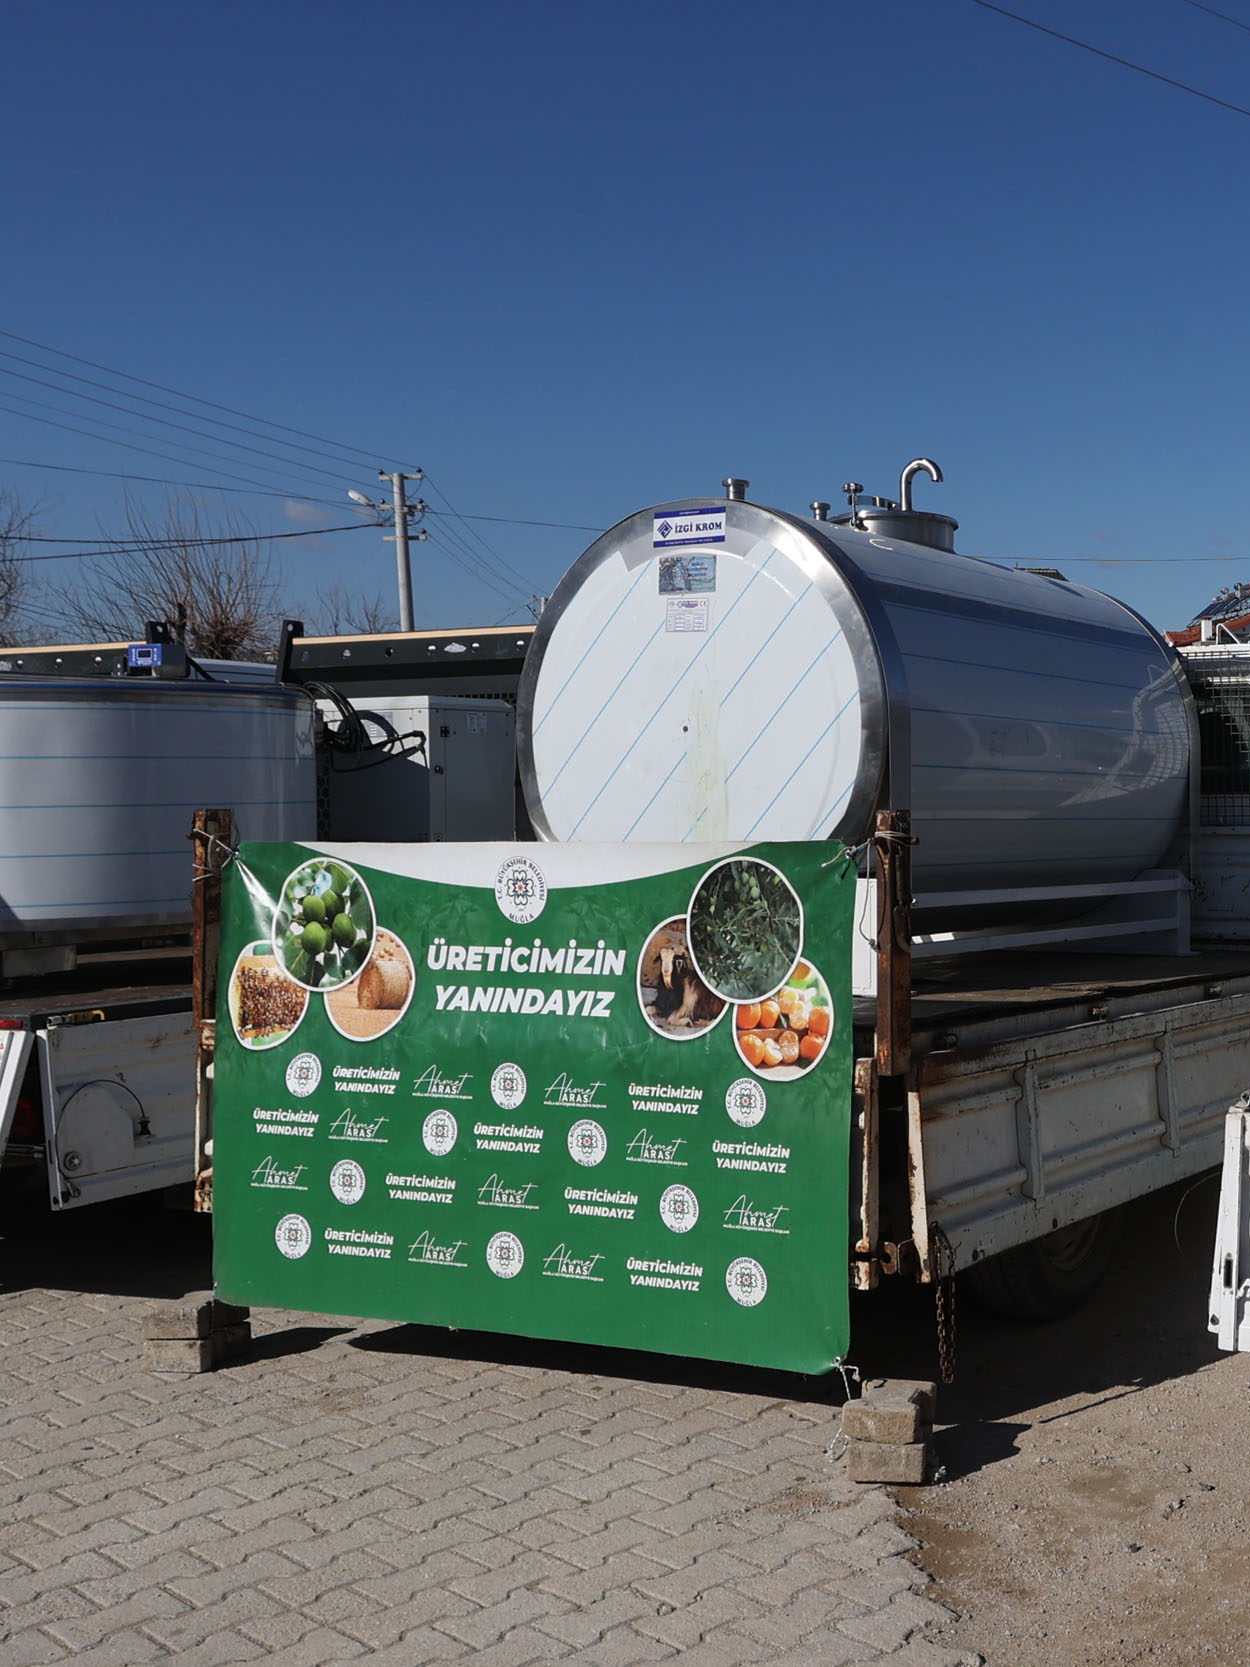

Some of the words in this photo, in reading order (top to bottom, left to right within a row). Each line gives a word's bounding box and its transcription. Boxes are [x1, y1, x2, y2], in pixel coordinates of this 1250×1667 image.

[674, 521, 693, 534] İZGİ
[695, 521, 722, 532] KROM
[497, 857, 527, 884] BÜYÜKŞEHİR
[528, 862, 545, 901] BELEDİYESİ
[508, 913, 534, 923] MUĞLA
[427, 937, 626, 976] ÜRETİCİMİZİN
[435, 984, 616, 1018] YANINDAYIZ
[333, 1066, 400, 1080] ÜRETİCİMİZİN
[413, 1064, 474, 1094] Ahmet
[335, 1082, 396, 1094] YANINDAYIZ
[431, 1085, 458, 1095] ARAS
[544, 1072, 607, 1103] Ahmet
[629, 1083, 703, 1099] ÜRETİCİMİZİN
[562, 1093, 589, 1103] ARAS
[632, 1100, 699, 1114] YANINDAYIZ
[253, 1108, 319, 1123] ÜRETİCİMİZİN
[329, 1107, 390, 1136] Ahmet
[256, 1124, 314, 1137] YANINDAYIZ
[346, 1129, 372, 1138] ARAS
[474, 1122, 544, 1139] ÜRETİCİMİZİN
[477, 1139, 540, 1153] YANINDAYIZ
[626, 1128, 687, 1159] Ahmet
[712, 1140, 790, 1158] ÜRETİCİMİZİN
[643, 1149, 671, 1160] ARAS
[251, 1155, 309, 1184] Ahmet
[717, 1158, 786, 1173] YANINDAYIZ
[267, 1175, 294, 1185] ARAS
[386, 1173, 456, 1189] ÜRETİCİMİZİN
[477, 1173, 539, 1203] Ahmet
[389, 1190, 453, 1203] YANINDAYIZ
[494, 1194, 522, 1204] ARAS
[564, 1187, 638, 1205] ÜRETİCİMİZİN
[568, 1204, 635, 1219] YANINDAYIZ
[723, 1194, 790, 1228] Ahmet
[742, 1216, 772, 1228] ARAS
[325, 1228, 394, 1245] ÜRETİCİMİZİN
[328, 1244, 391, 1258] YANINDAYIZ
[408, 1230, 468, 1261] Ahmet
[425, 1251, 451, 1262] ARAS
[543, 1243, 606, 1275] Ahmet
[561, 1264, 588, 1276] ARAS
[627, 1257, 703, 1277] ÜRETİCİMİZİN
[630, 1275, 699, 1291] YANINDAYIZ
